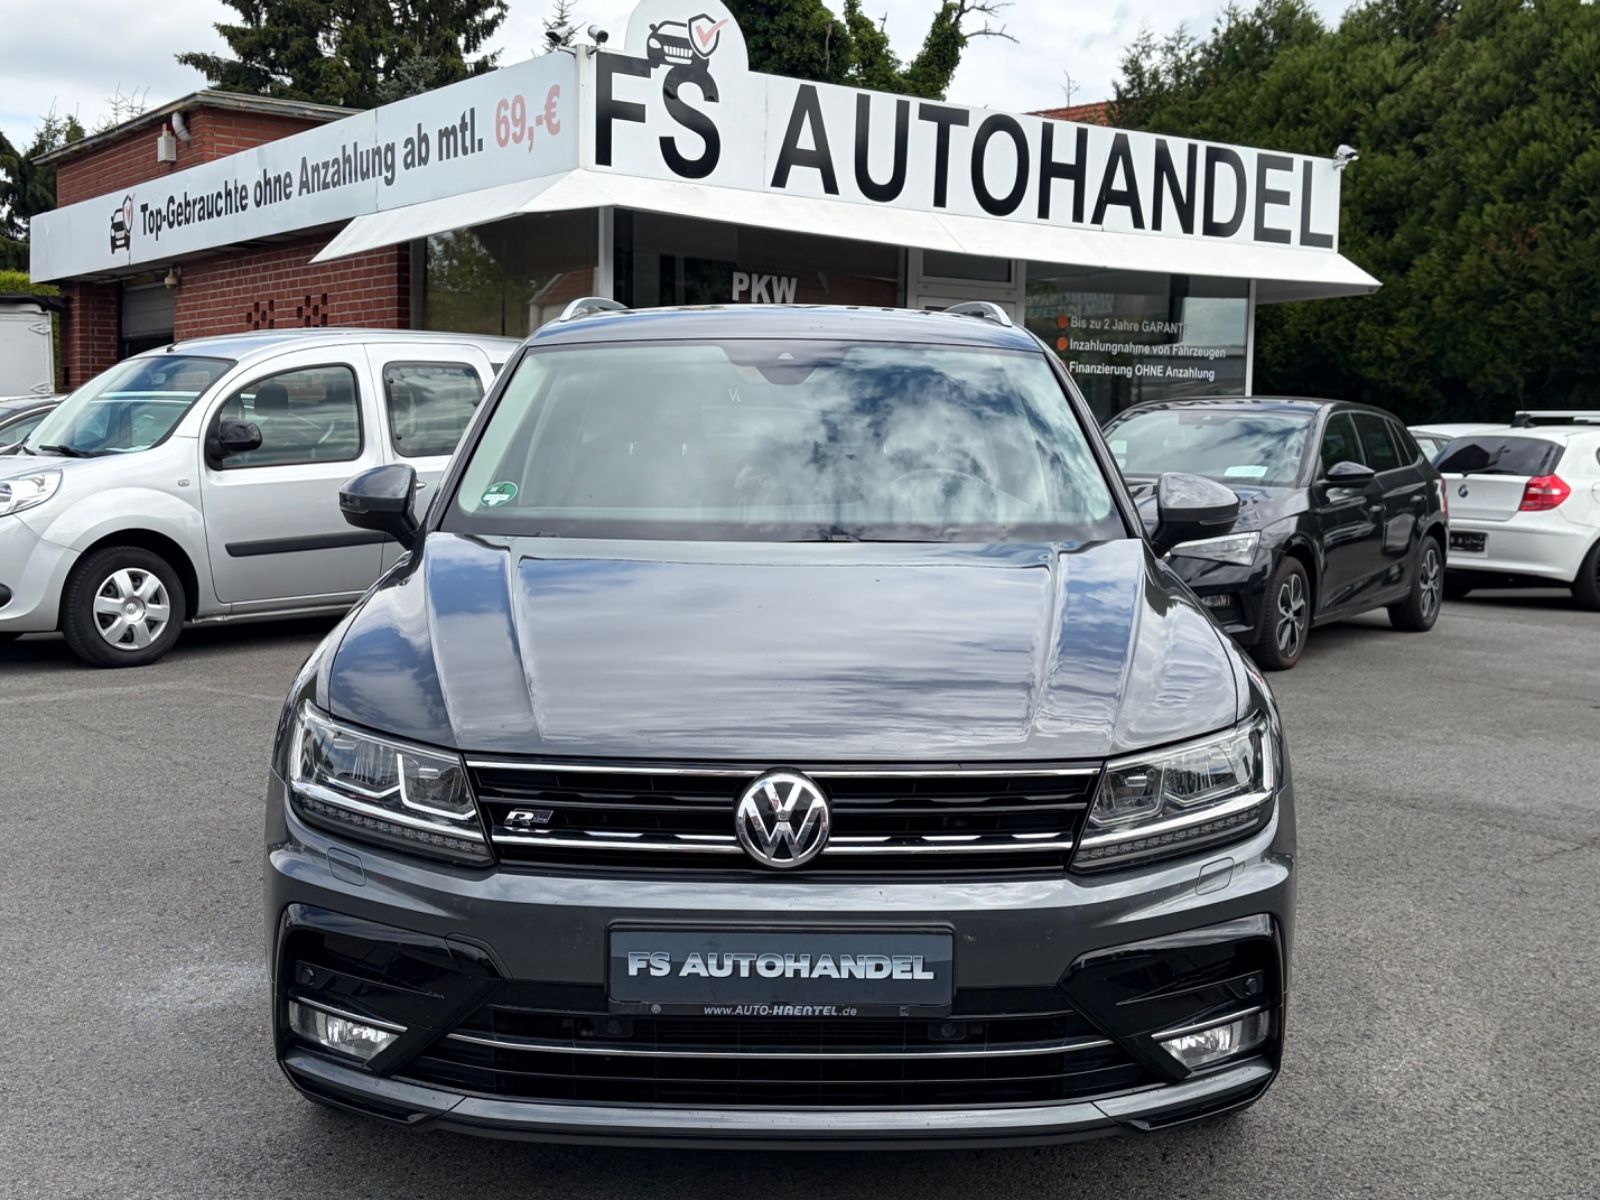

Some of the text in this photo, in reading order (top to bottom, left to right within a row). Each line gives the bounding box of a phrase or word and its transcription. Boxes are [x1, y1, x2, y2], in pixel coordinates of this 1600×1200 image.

[140, 84, 561, 241] Top-Gebrauchte ohne Anzahlung ab mtl. 69,-€
[594, 52, 1334, 248] FS AUTOHANDEL
[732, 271, 798, 304] PKW
[1070, 315, 1088, 329] Bis
[1089, 319, 1101, 330] zu
[1103, 317, 1110, 331] 2
[1111, 318, 1139, 333] Jahre
[1069, 338, 1226, 361] Inzahlungnahme von Fahrzeugen
[1069, 361, 1215, 383] Finanzierung OHNE Anzahlung
[627, 951, 935, 981] FS AUTOHANDEL
